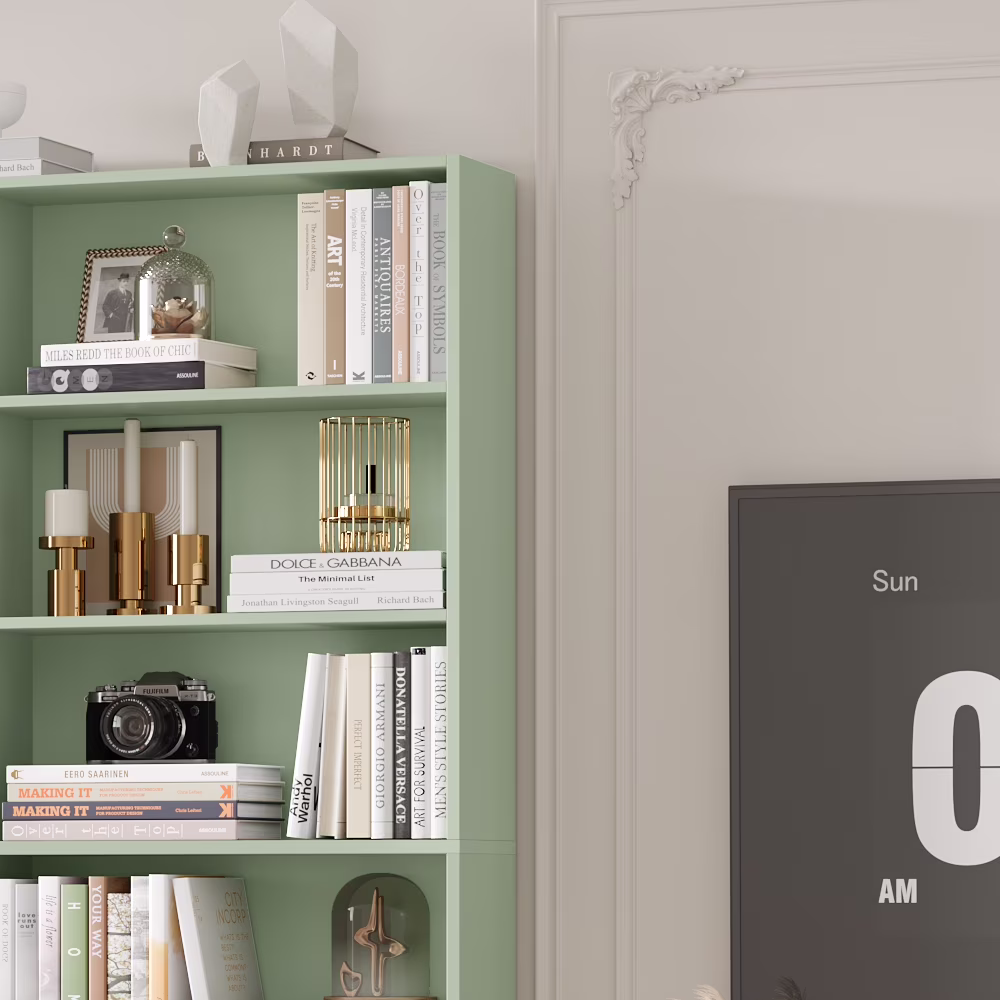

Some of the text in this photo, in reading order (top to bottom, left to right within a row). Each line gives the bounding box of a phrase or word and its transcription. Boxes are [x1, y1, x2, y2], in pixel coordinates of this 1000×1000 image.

[16, 163, 35, 172] Bach
[197, 144, 333, 162] BNHARDT
[327, 235, 343, 266] ART
[432, 230, 446, 269] BOOK
[378, 237, 392, 334] ANTIQUAIRES
[394, 264, 406, 316] BORDEAUX
[432, 285, 446, 355] SYMBOLS
[45, 344, 191, 362] MILES REDD THE BOOK OF CHIC
[270, 558, 317, 570] DOLCE
[327, 556, 402, 569] GABBANA
[298, 575, 316, 583] The
[357, 574, 375, 582] List
[872, 569, 919, 592] Sun
[375, 683, 385, 809] GIORGIO ARMANI
[396, 667, 406, 824] DONATELLA VERSACE
[434, 661, 447, 819] MEN'S STYLE STORIES
[64, 770, 85, 779] EERO
[87, 769, 129, 779] SAARINEN
[414, 726, 425, 827] ART FOR SURVIVAL
[18, 788, 92, 799] MAKING IT
[289, 773, 313, 823] Andy Warhol
[12, 806, 89, 817] MAKING IT
[878, 878, 918, 904] AM
[91, 884, 102, 958] YOUR WAY
